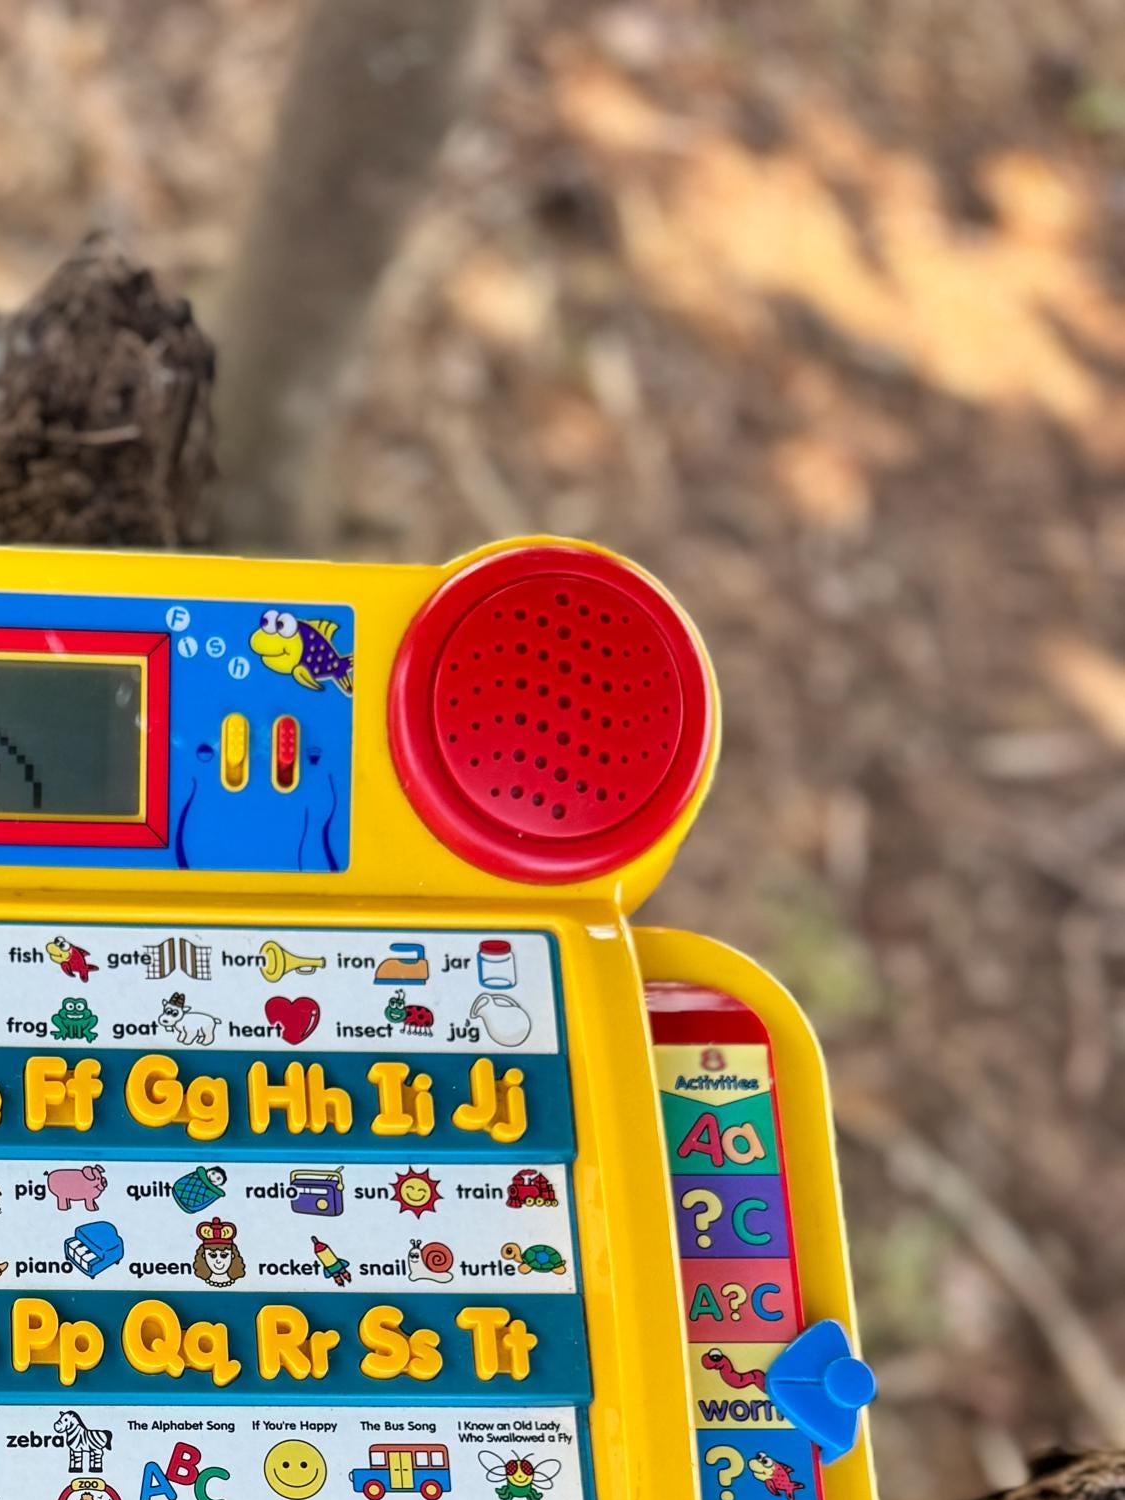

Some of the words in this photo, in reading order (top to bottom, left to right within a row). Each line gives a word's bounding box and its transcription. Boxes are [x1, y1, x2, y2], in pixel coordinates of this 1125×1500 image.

[9, 948, 44, 963] fish
[107, 951, 152, 969] gate
[222, 951, 267, 968] horn
[337, 953, 375, 969] iron
[442, 955, 471, 972] jar
[7, 1017, 48, 1037] frog
[113, 1021, 158, 1038] goat
[229, 1022, 284, 1038] heart
[336, 1022, 393, 1038] insect
[447, 1022, 480, 1042] jug
[675, 1075, 759, 1090] Activities
[24, 1056, 104, 1132] Ff
[126, 1054, 229, 1141] Gg
[248, 1061, 353, 1134] Hh
[366, 1062, 434, 1136] Ii
[452, 1057, 528, 1143] Jj
[677, 1112, 767, 1168] Aa
[15, 1181, 46, 1200] pig
[127, 1182, 173, 1201] quilt
[246, 1184, 297, 1199] radio
[355, 1186, 389, 1199] sun
[456, 1184, 503, 1199] train
[15, 1258, 73, 1278] piano
[129, 1261, 193, 1279] queen
[259, 1260, 320, 1276] rocket
[360, 1260, 406, 1277] snail
[461, 1260, 516, 1277] turtle
[11, 1298, 104, 1386] Pp
[122, 1299, 242, 1388] Qq
[256, 1304, 340, 1380] Rr
[359, 1305, 443, 1381] Ss
[455, 1306, 538, 1381] Tt
[127, 1420, 149, 1430] The
[151, 1420, 204, 1432] Alphabet
[207, 1420, 235, 1433] Song
[252, 1421, 259, 1430] If
[263, 1421, 296, 1430] You're
[300, 1421, 337, 1433] Happy
[360, 1422, 383, 1431] The
[385, 1422, 406, 1431] Bus
[408, 1422, 436, 1433] Song
[458, 1422, 461, 1430] I
[464, 1421, 494, 1430] Know
[513, 1421, 532, 1431] Old
[535, 1421, 560, 1432] Lady
[7, 1432, 64, 1448] zebra
[459, 1433, 484, 1442] Who
[487, 1433, 545, 1442] Swallowed
[558, 1433, 572, 1444] Fly
